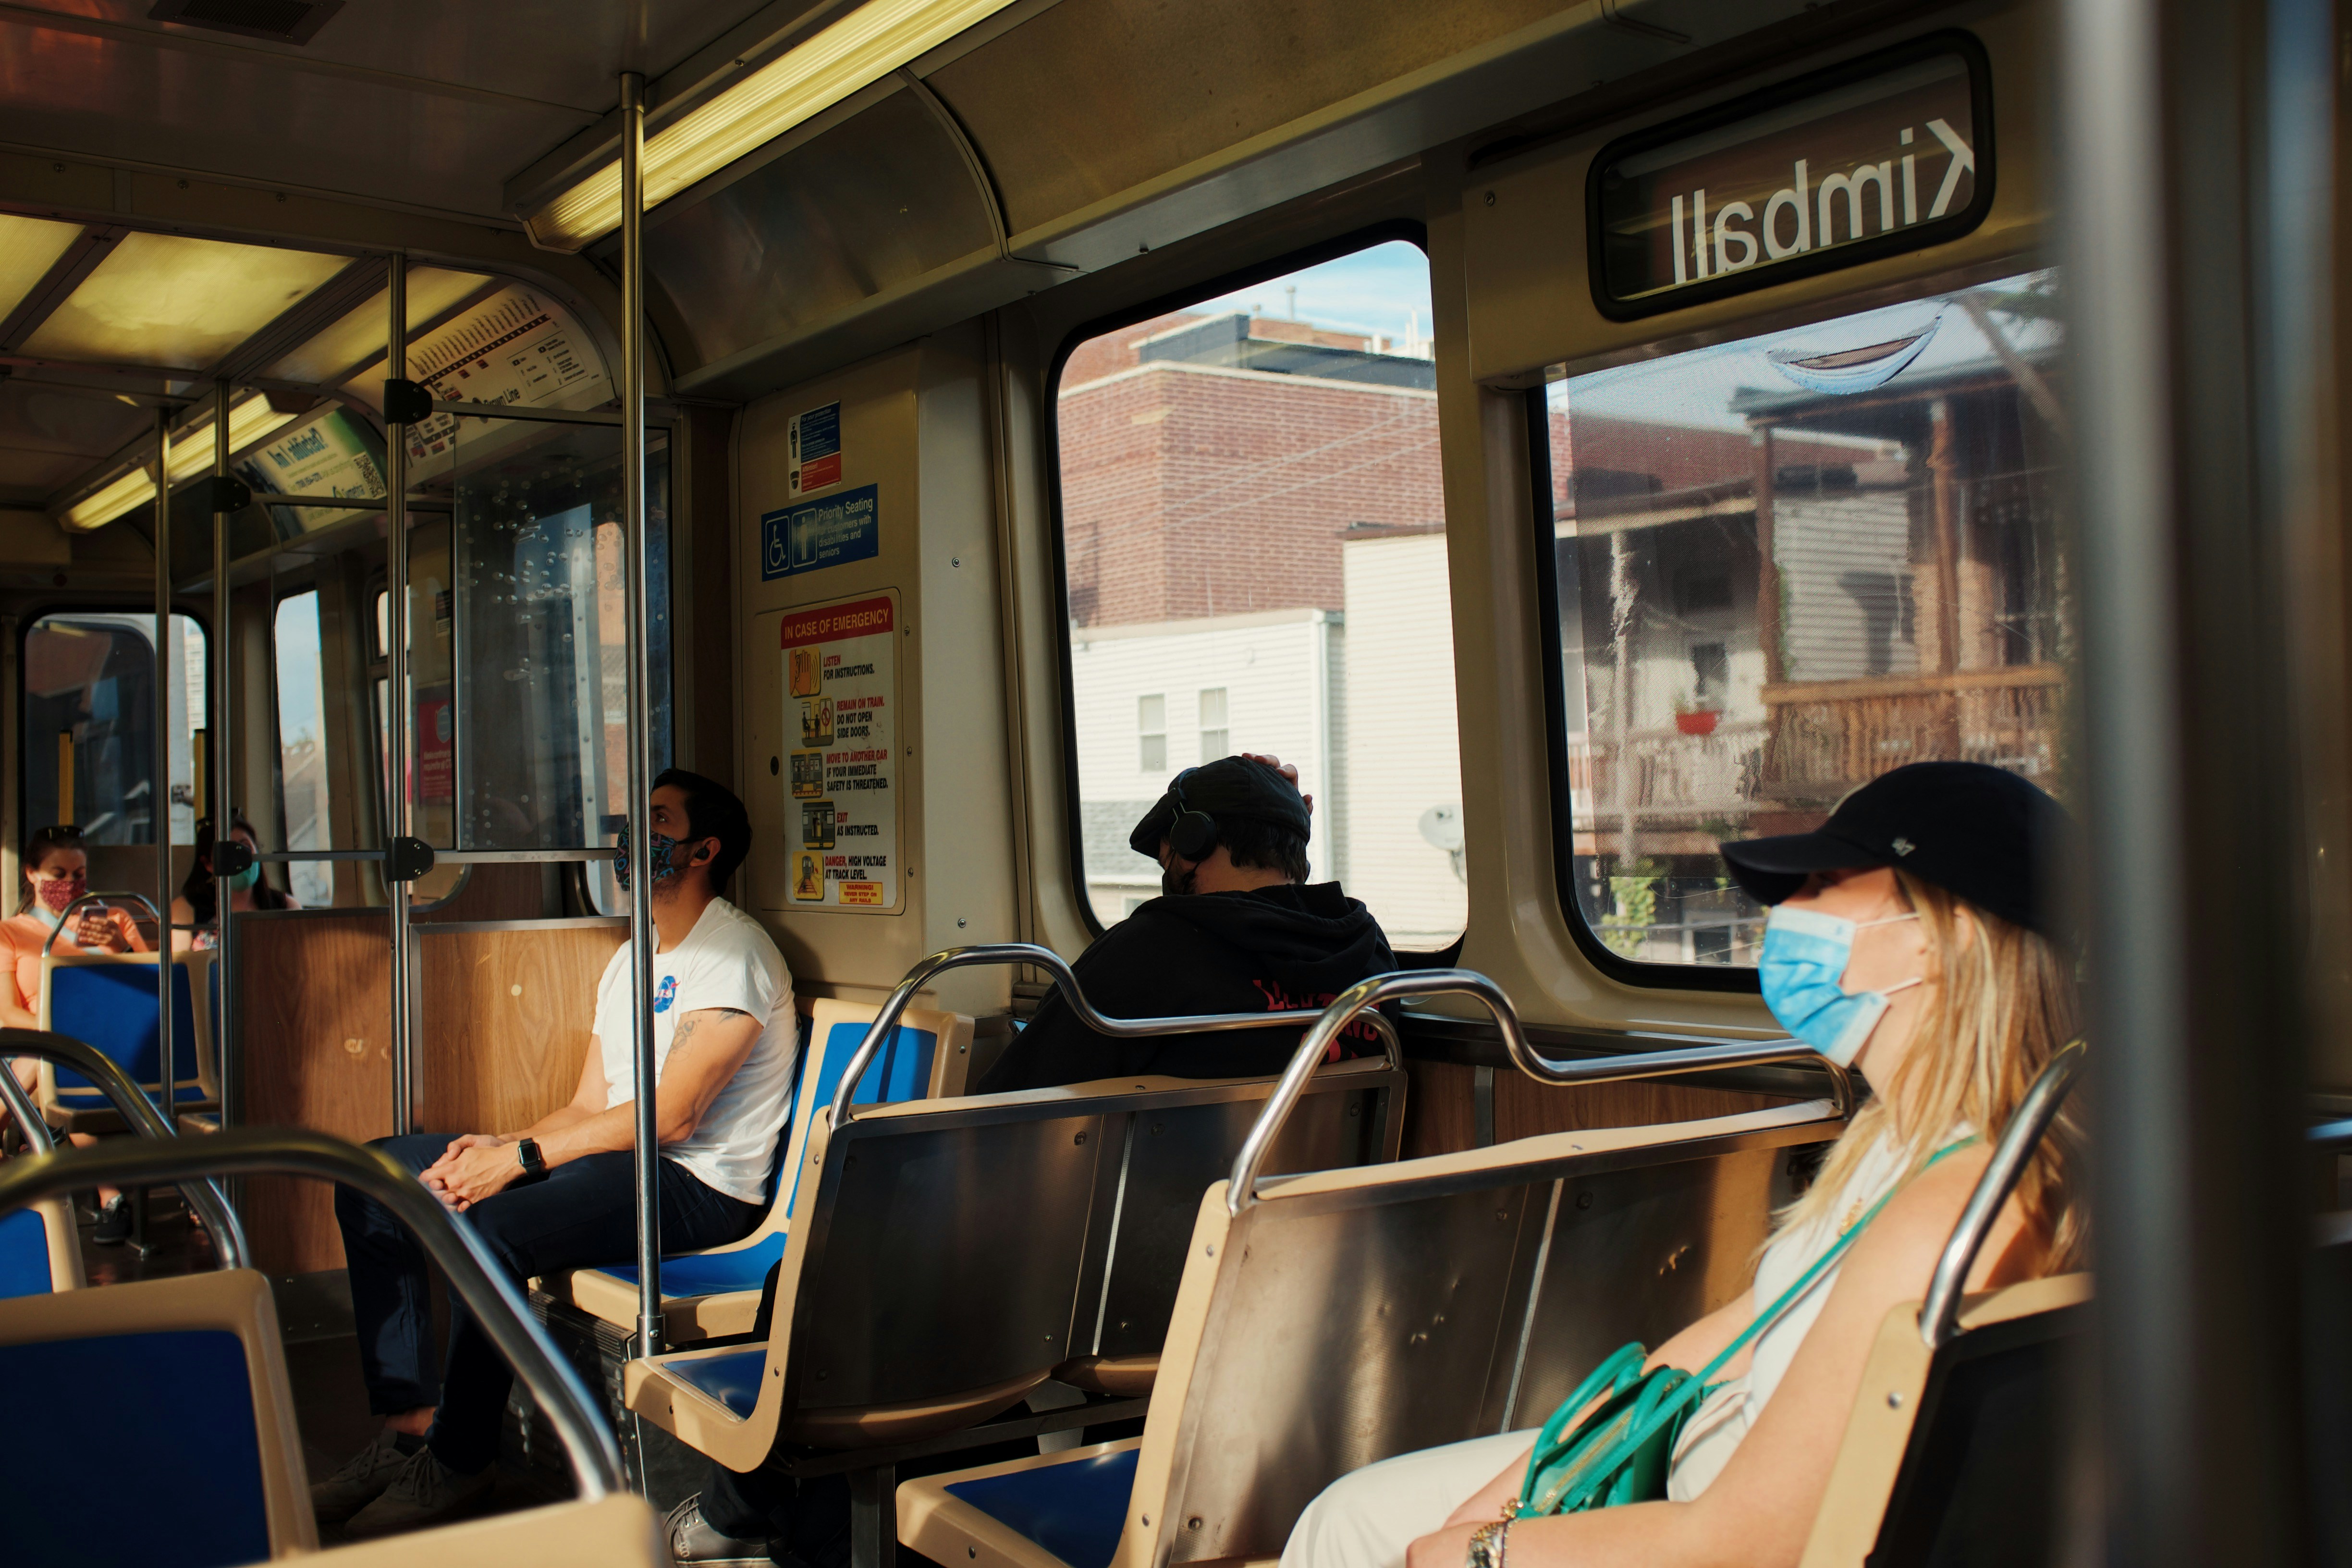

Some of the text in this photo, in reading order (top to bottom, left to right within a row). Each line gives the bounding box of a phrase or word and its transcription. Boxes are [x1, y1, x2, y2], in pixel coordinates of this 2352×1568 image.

[503, 388, 520, 404] Line
[819, 498, 873, 521] Priority Seating
[827, 519, 858, 533] customers
[859, 514, 871, 526] with
[819, 528, 861, 547] disabilities and
[819, 547, 840, 559] seniors
[785, 608, 889, 640] IN CASE OF EMERGENCY
[823, 655, 841, 667] LISTEN
[823, 663, 874, 680] FOR INSTRUCTIONS.
[837, 696, 884, 711] REMAIN ON TRAIN.
[837, 711, 872, 725] DO NOT OPEN
[837, 725, 870, 738] SIDE DOORS.
[826, 749, 887, 764] MOVE TO ANOTHER CAR
[827, 764, 877, 777] IF YOUR IMMEDIATE
[827, 778, 888, 792] SAFETY IS THREATENED.
[837, 812, 848, 822] EXIT
[837, 825, 879, 836] AS INSTRUCTED.
[825, 856, 886, 868] DANGER, HIGH VOLTAGE
[825, 869, 867, 880] AT TRACK LEVEL.
